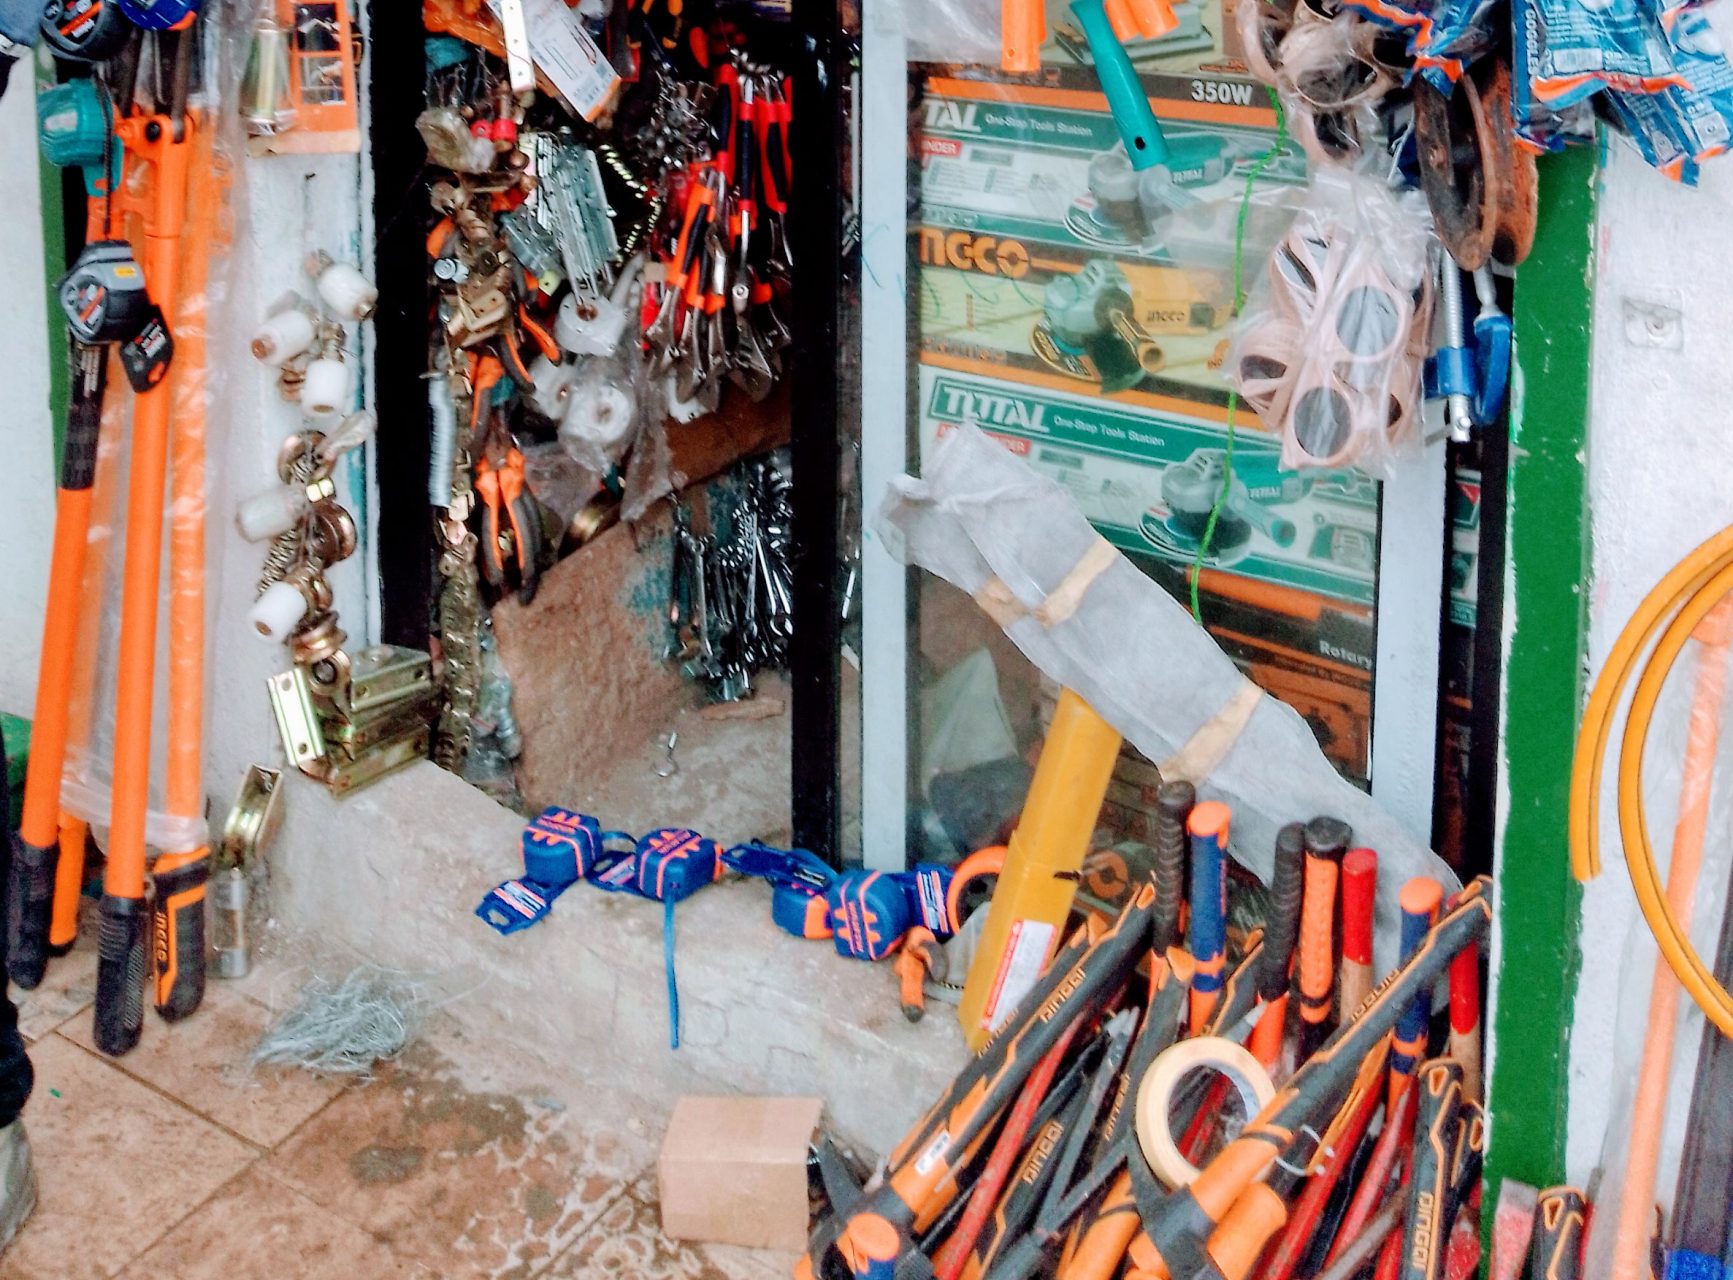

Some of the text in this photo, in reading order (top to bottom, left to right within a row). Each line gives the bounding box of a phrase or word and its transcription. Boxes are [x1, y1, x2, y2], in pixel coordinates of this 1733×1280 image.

[1191, 80, 1253, 106] 350W
[926, 100, 982, 132] TAL
[1030, 118, 1054, 132] Tools
[1056, 121, 1092, 137] Station
[919, 227, 1030, 278] NGCO
[943, 386, 1166, 447] TOTAL One-Stop Tools Station
